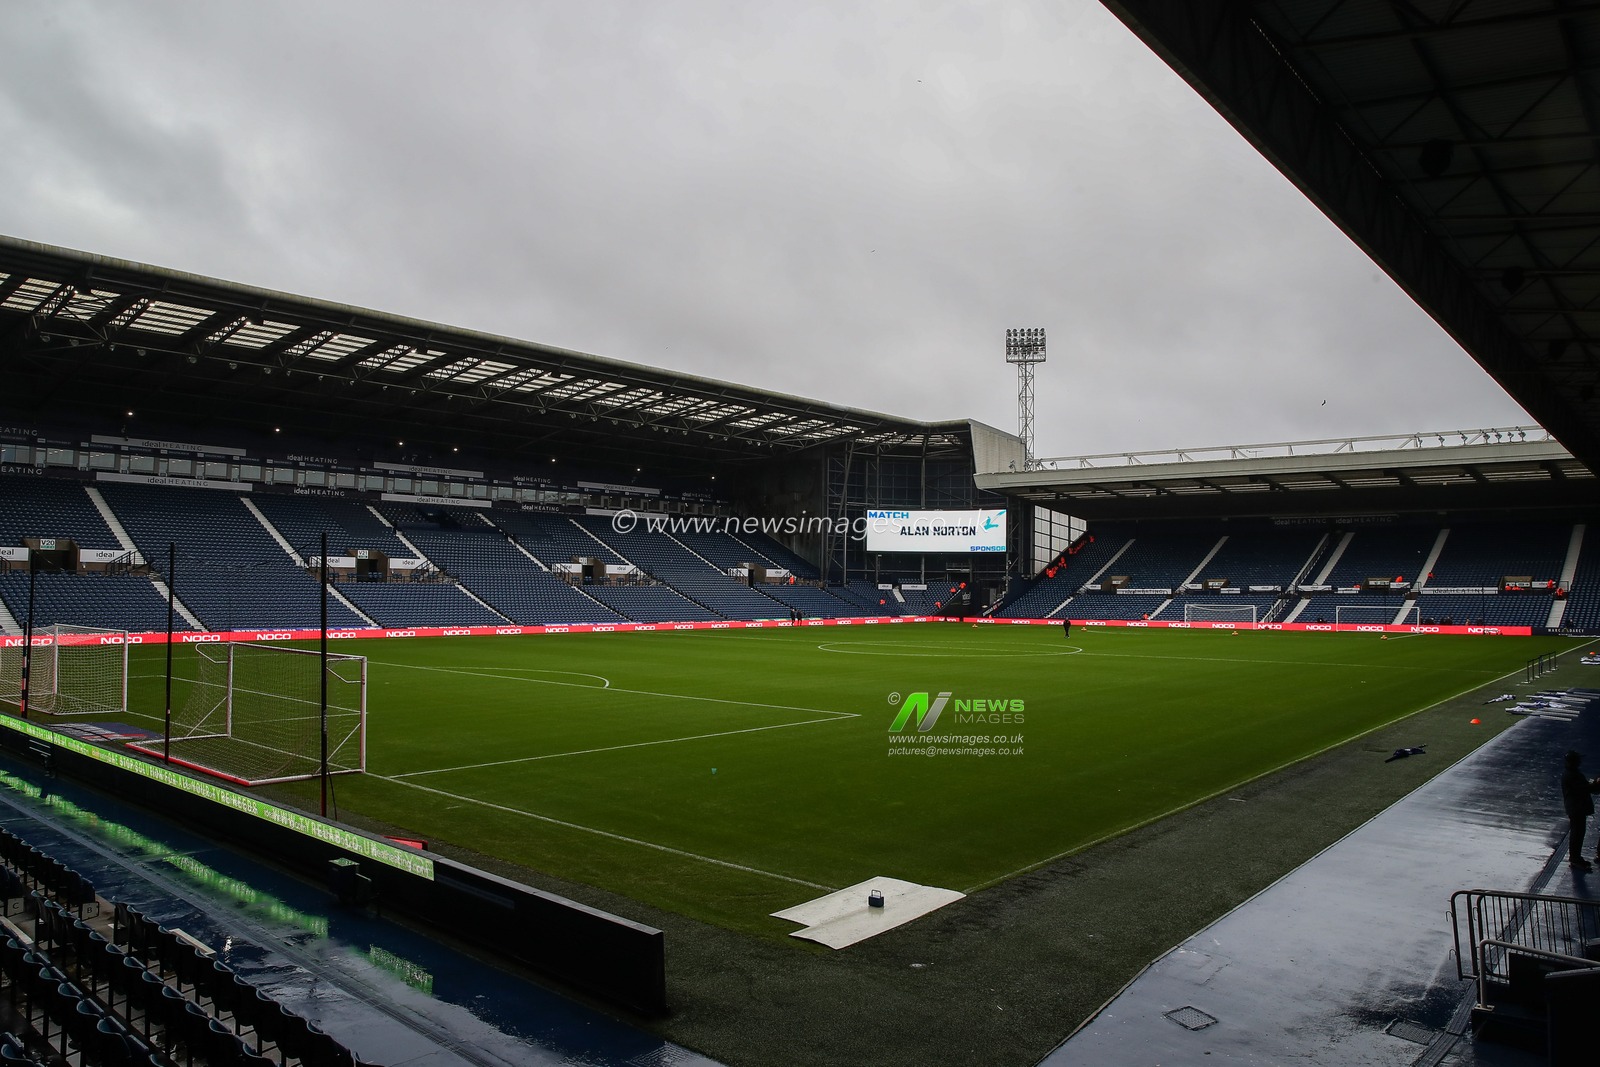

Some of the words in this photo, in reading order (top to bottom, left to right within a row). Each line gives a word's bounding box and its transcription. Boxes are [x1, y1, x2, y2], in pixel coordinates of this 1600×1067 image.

[162, 442, 202, 451] HEATING
[304, 456, 338, 464] HEATING
[168, 478, 208, 486] HEATING
[311, 489, 345, 497] HEATING
[868, 511, 909, 519] MATCH
[900, 526, 929, 536] ALAN
[933, 526, 976, 536] NORTON
[6, 638, 52, 647] NOCO
[100, 636, 143, 645] NOCO
[182, 634, 220, 643] NOCO
[13, 902, 19, 910] C
[87, 906, 93, 914] B
